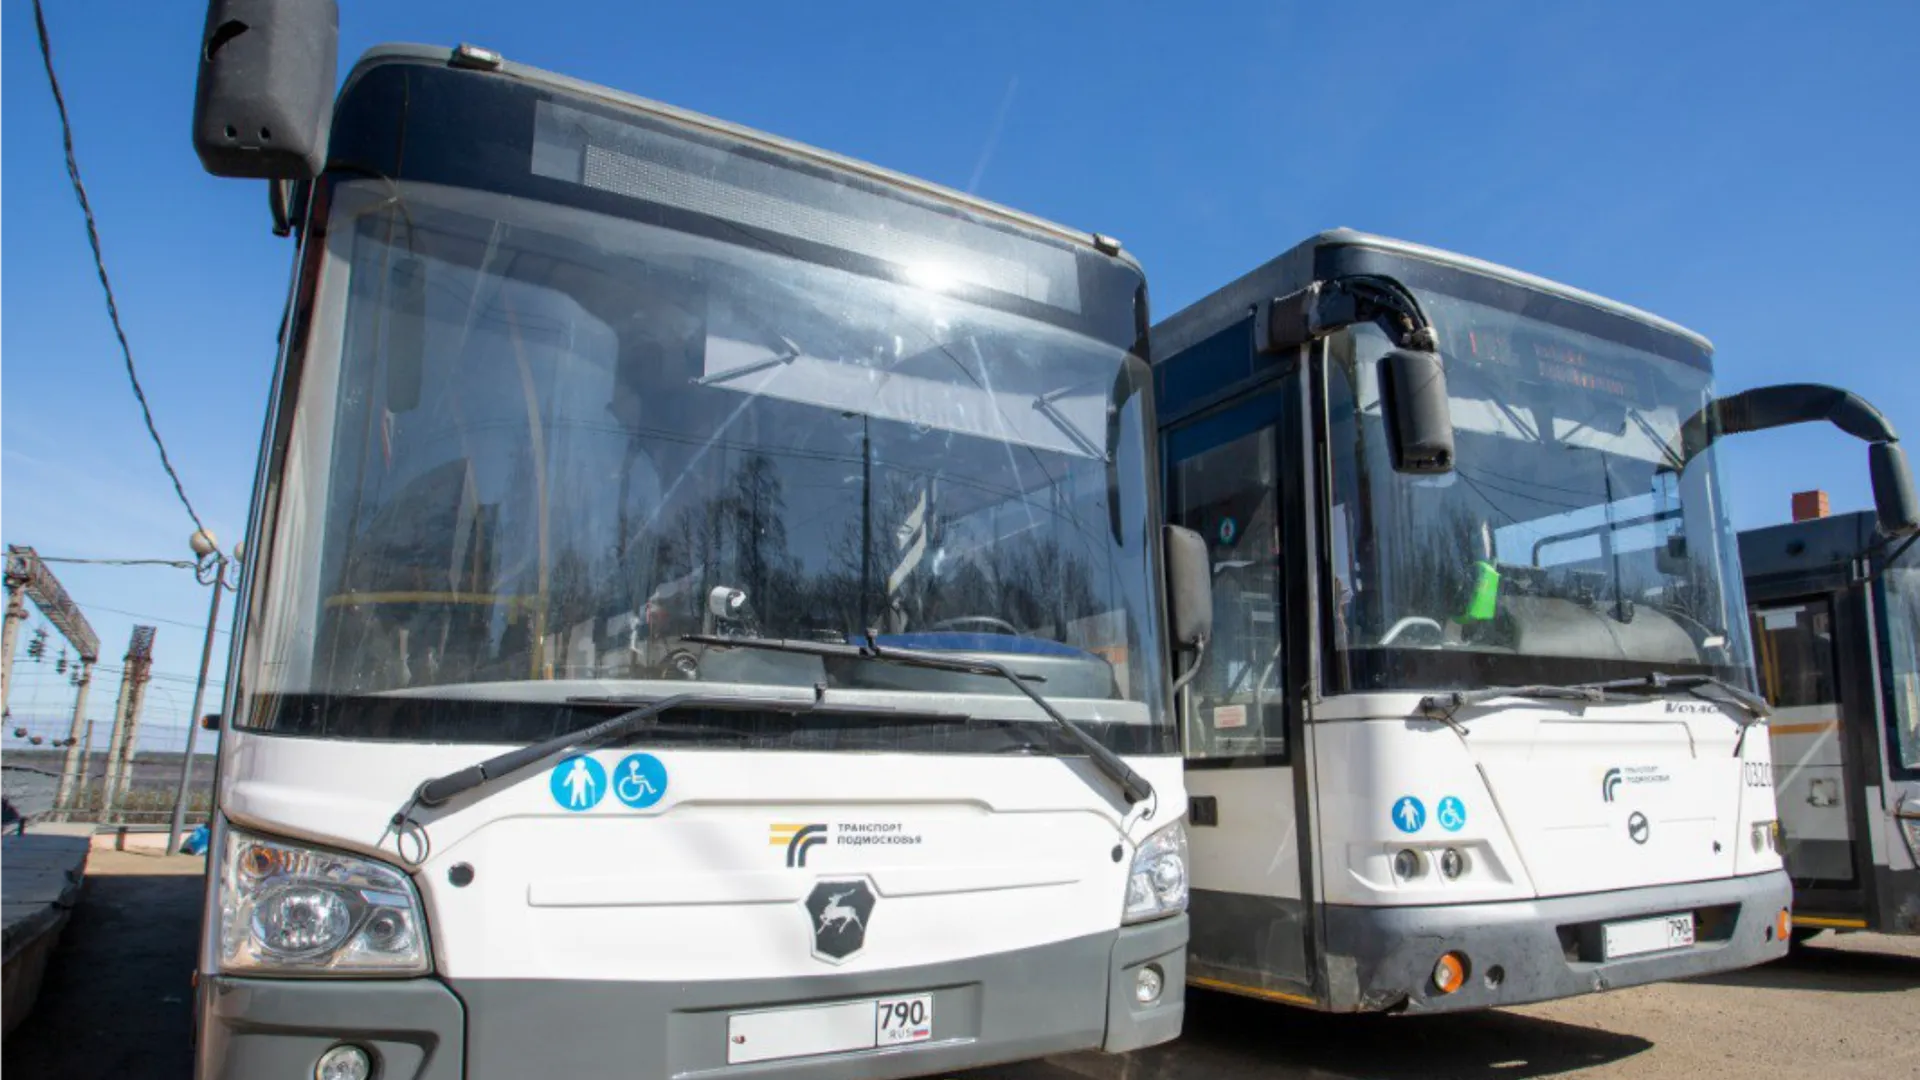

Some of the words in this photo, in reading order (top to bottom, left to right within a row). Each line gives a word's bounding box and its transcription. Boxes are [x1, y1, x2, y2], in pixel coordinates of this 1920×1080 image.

[838, 823, 902, 832] ТРАНСПОРТ
[837, 835, 922, 845] ПОДМОСКОВЬЯ
[1669, 919, 1690, 937] 790
[880, 1000, 924, 1030] 790
[888, 1028, 914, 1040] RUS
